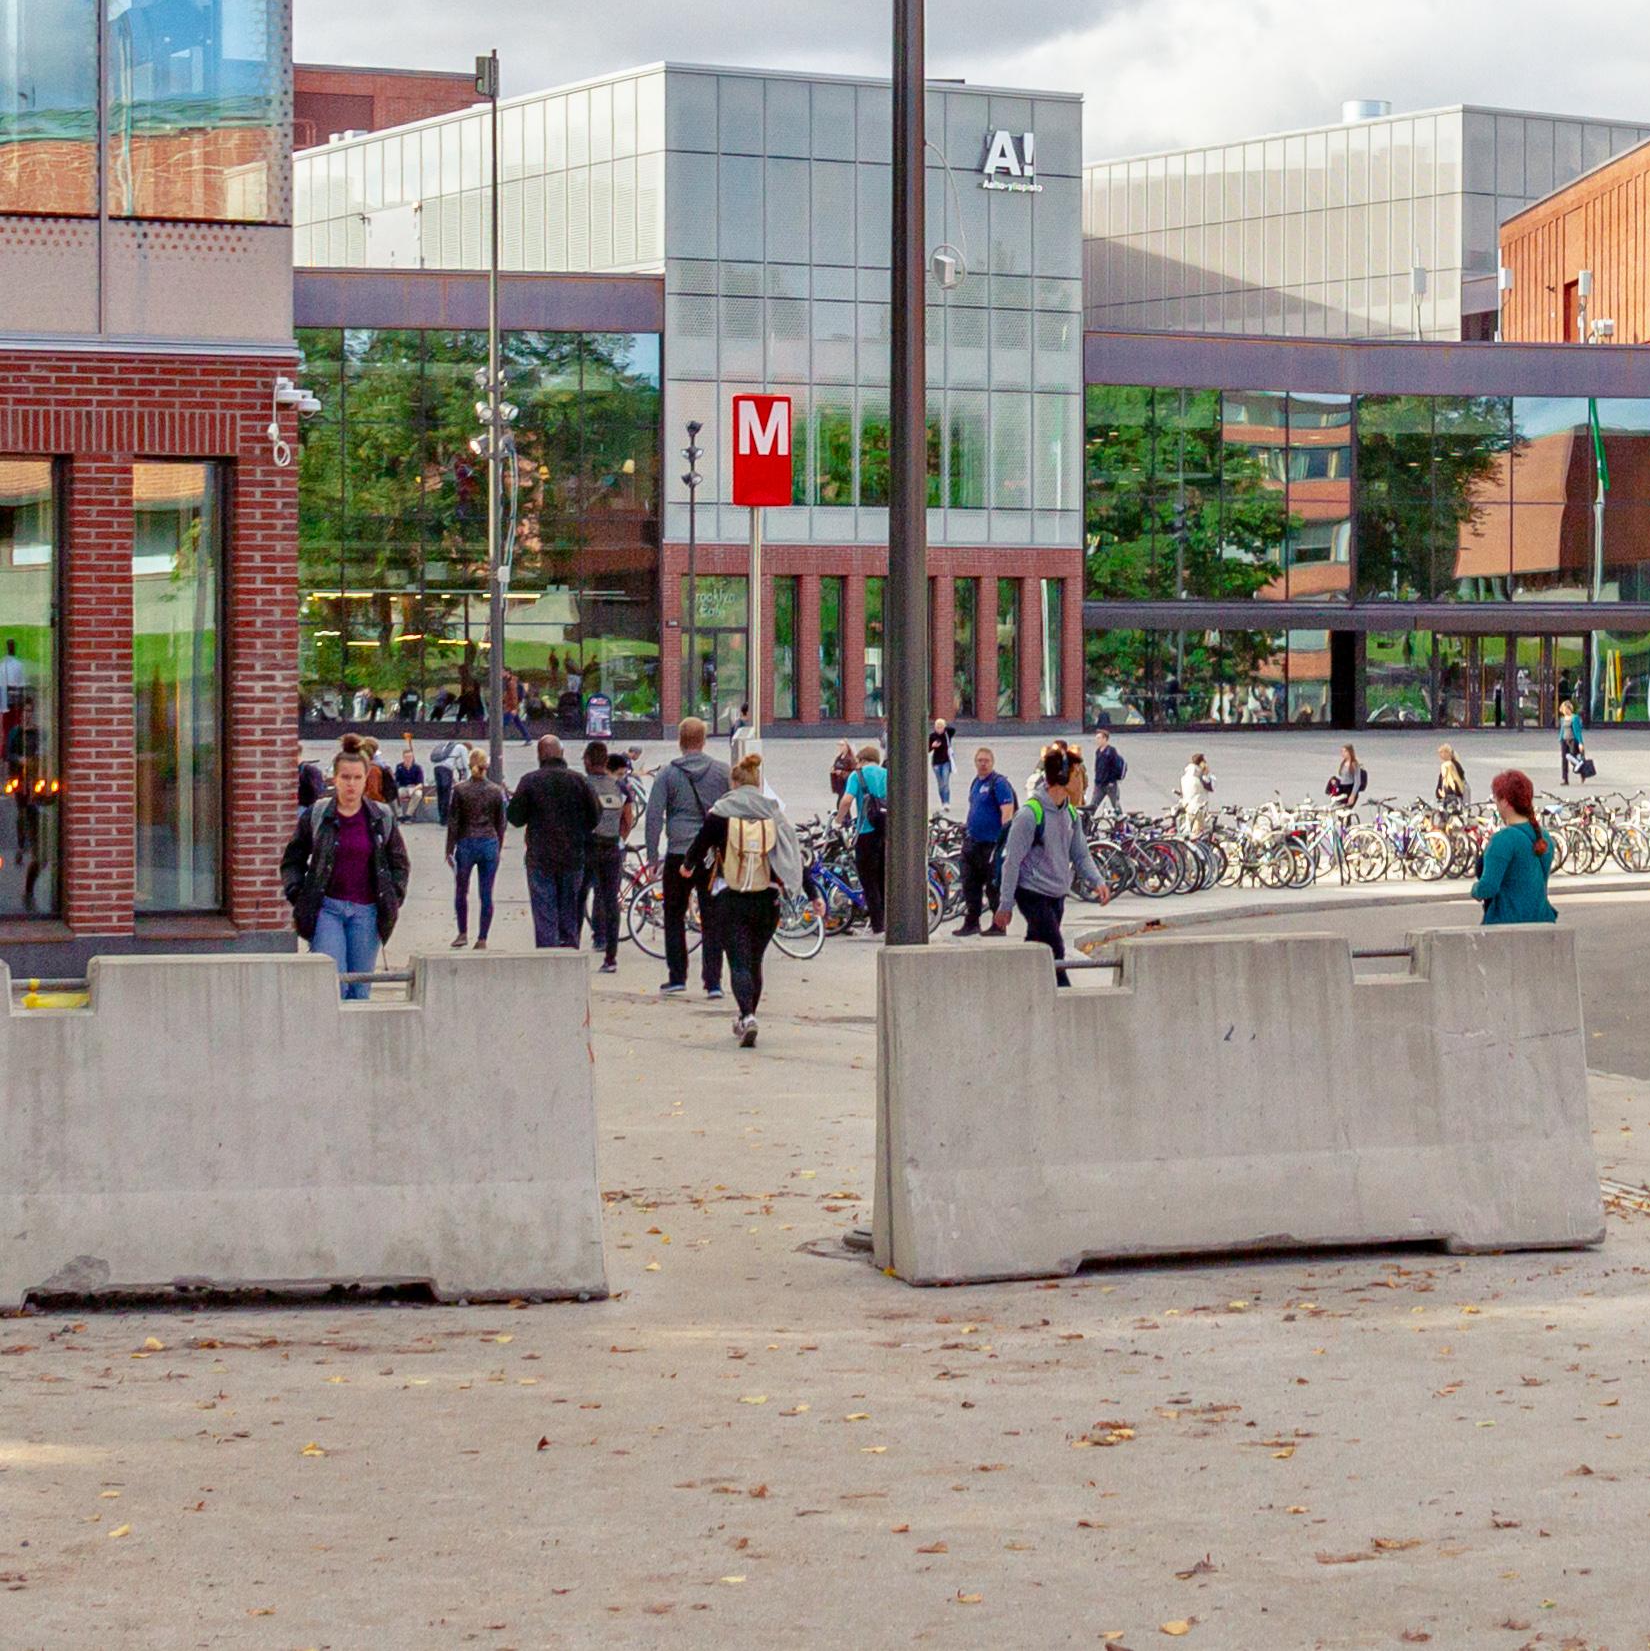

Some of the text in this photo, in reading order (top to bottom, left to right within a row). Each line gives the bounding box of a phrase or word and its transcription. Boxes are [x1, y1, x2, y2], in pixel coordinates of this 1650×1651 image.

[983, 130, 1034, 177] A!
[738, 400, 789, 456] M
[694, 589, 738, 606] rooklyn
